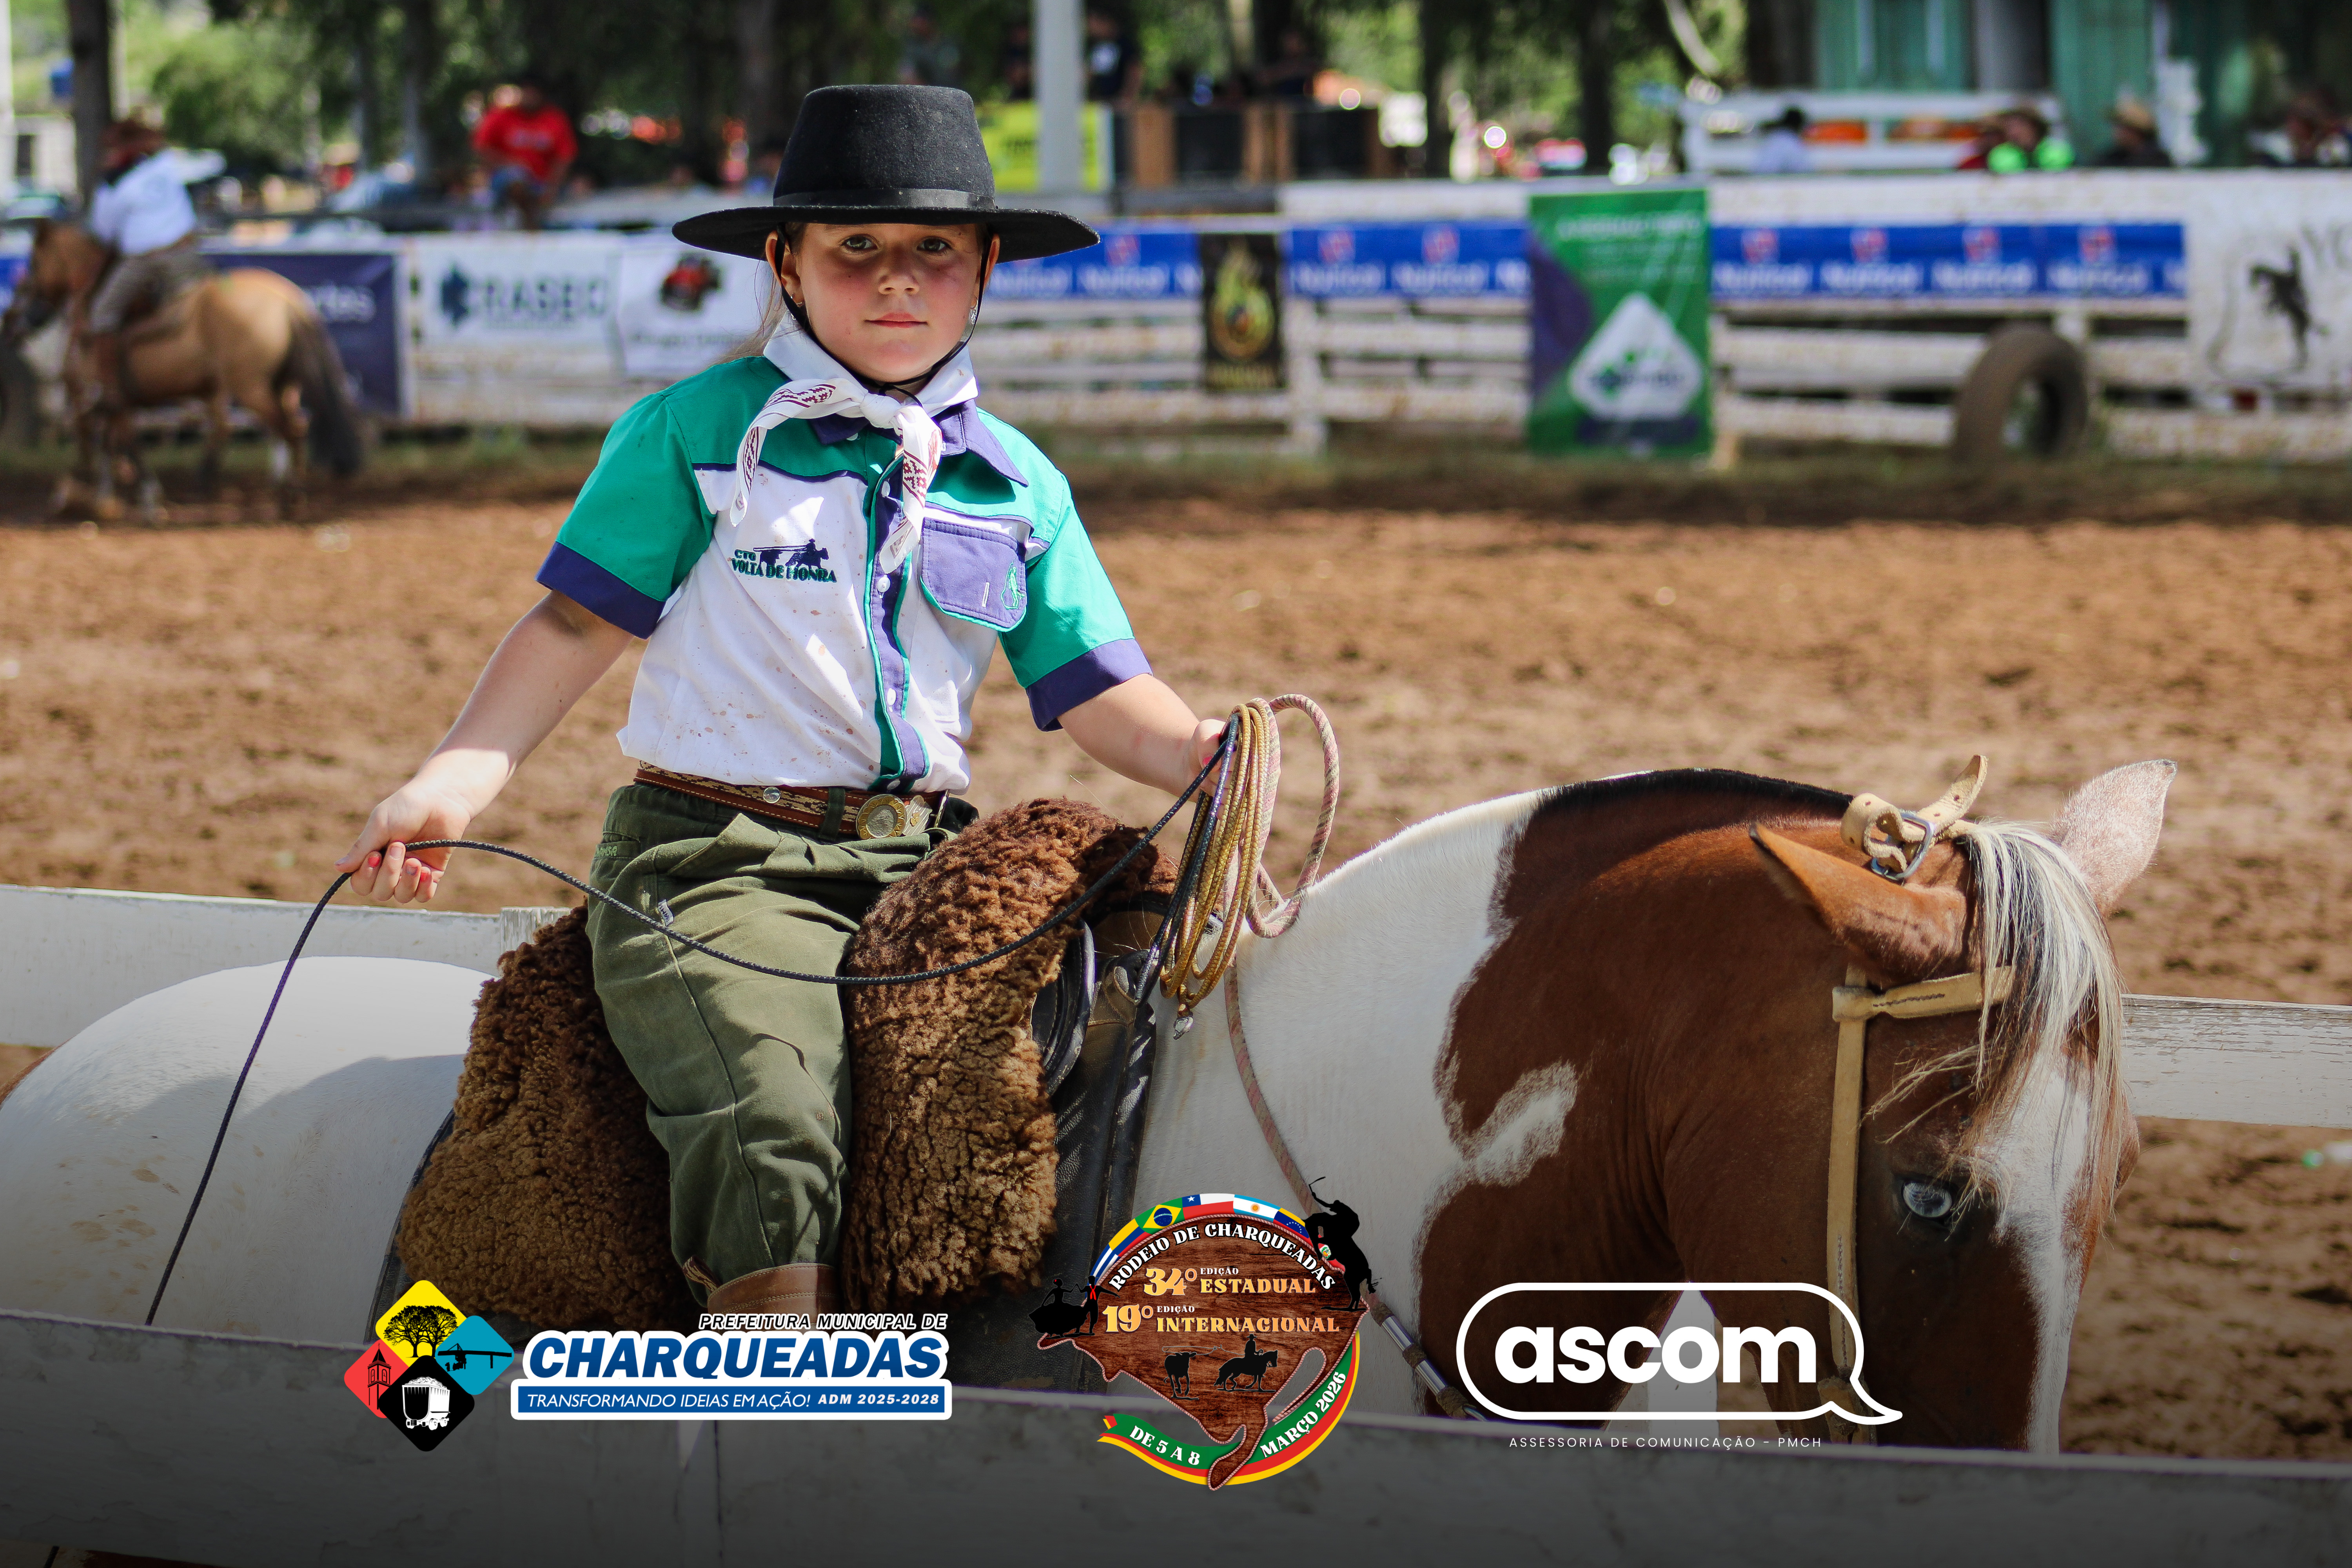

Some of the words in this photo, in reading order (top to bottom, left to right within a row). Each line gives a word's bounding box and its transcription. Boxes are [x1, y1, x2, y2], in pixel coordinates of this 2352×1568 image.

[735, 549, 756, 561] CTG
[731, 558, 764, 577] VOLTA
[766, 564, 784, 579] DE
[786, 565, 837, 583] HONRA
